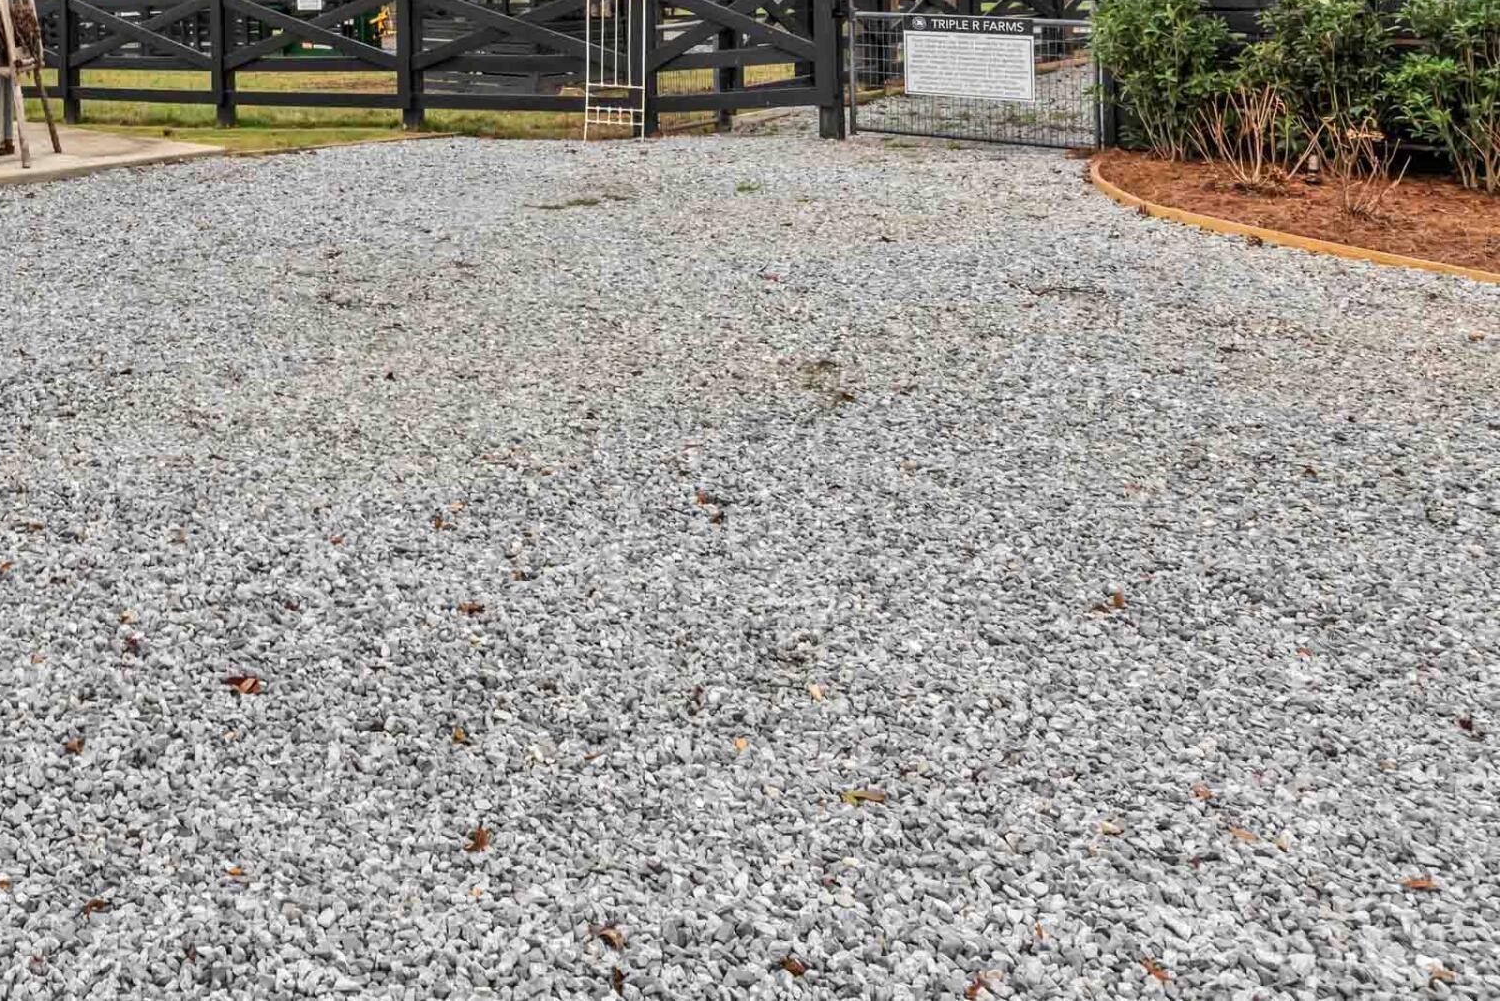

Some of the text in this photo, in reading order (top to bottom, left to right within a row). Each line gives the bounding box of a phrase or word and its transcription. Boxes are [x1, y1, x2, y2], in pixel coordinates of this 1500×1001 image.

[931, 19, 1025, 33] TRIPLE R FARMS
